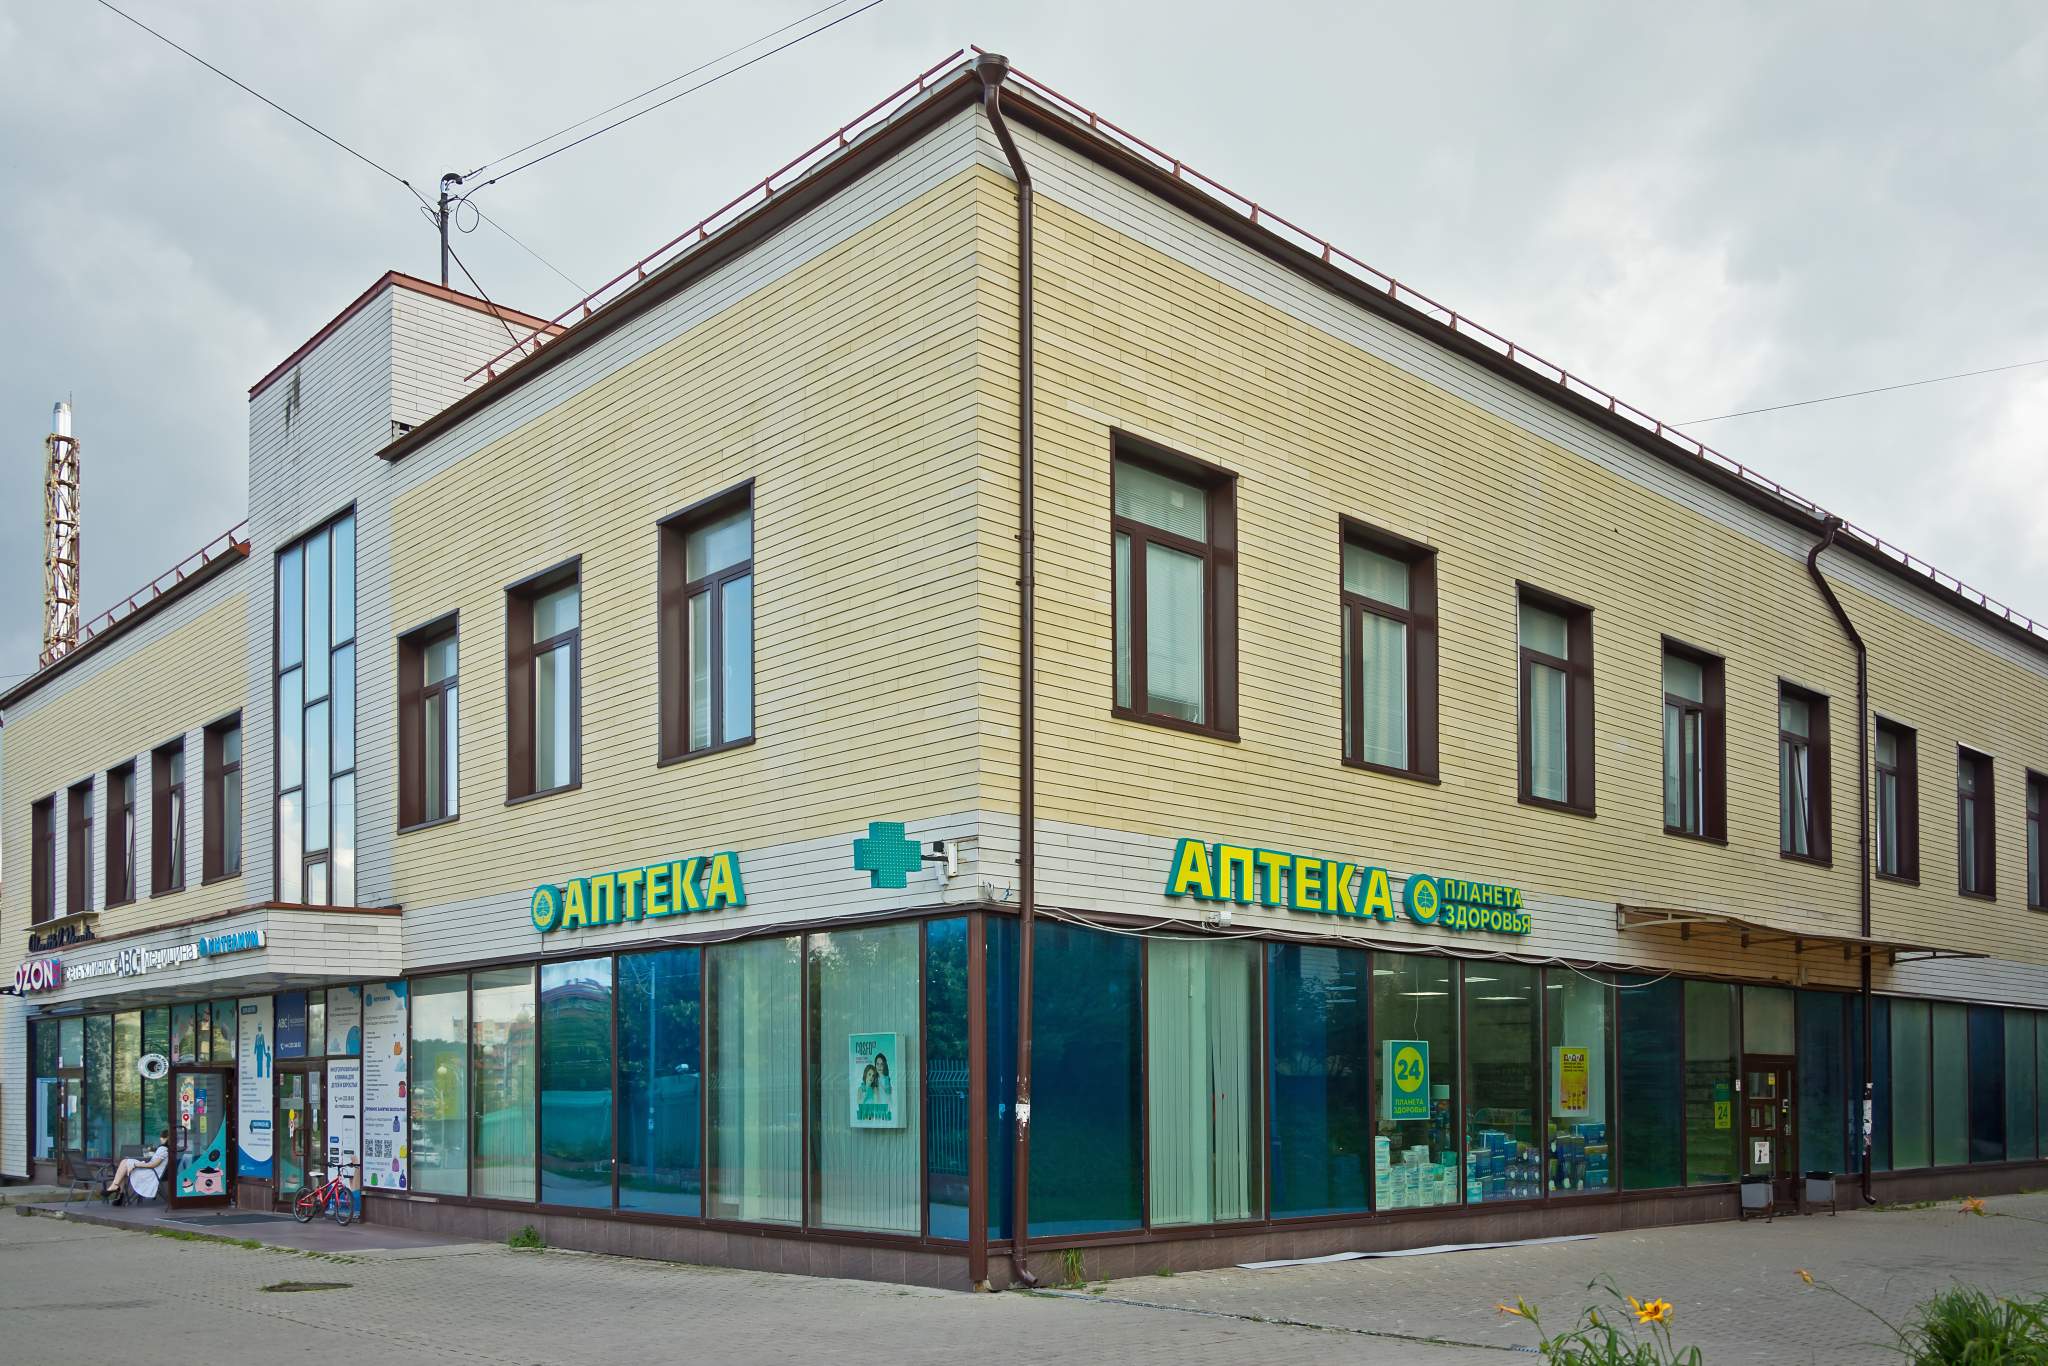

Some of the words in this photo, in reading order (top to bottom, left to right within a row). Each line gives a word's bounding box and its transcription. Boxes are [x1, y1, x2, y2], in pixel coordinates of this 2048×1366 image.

[560, 851, 747, 929] АПТЕКА
[1166, 838, 1396, 922] АПТЕКА
[1440, 878, 1524, 911] ПЛАНЕТА
[1441, 904, 1532, 935] ЗДОРОВЬЯ
[15, 958, 54, 993] OZON
[1397, 1058, 1422, 1081] 24
